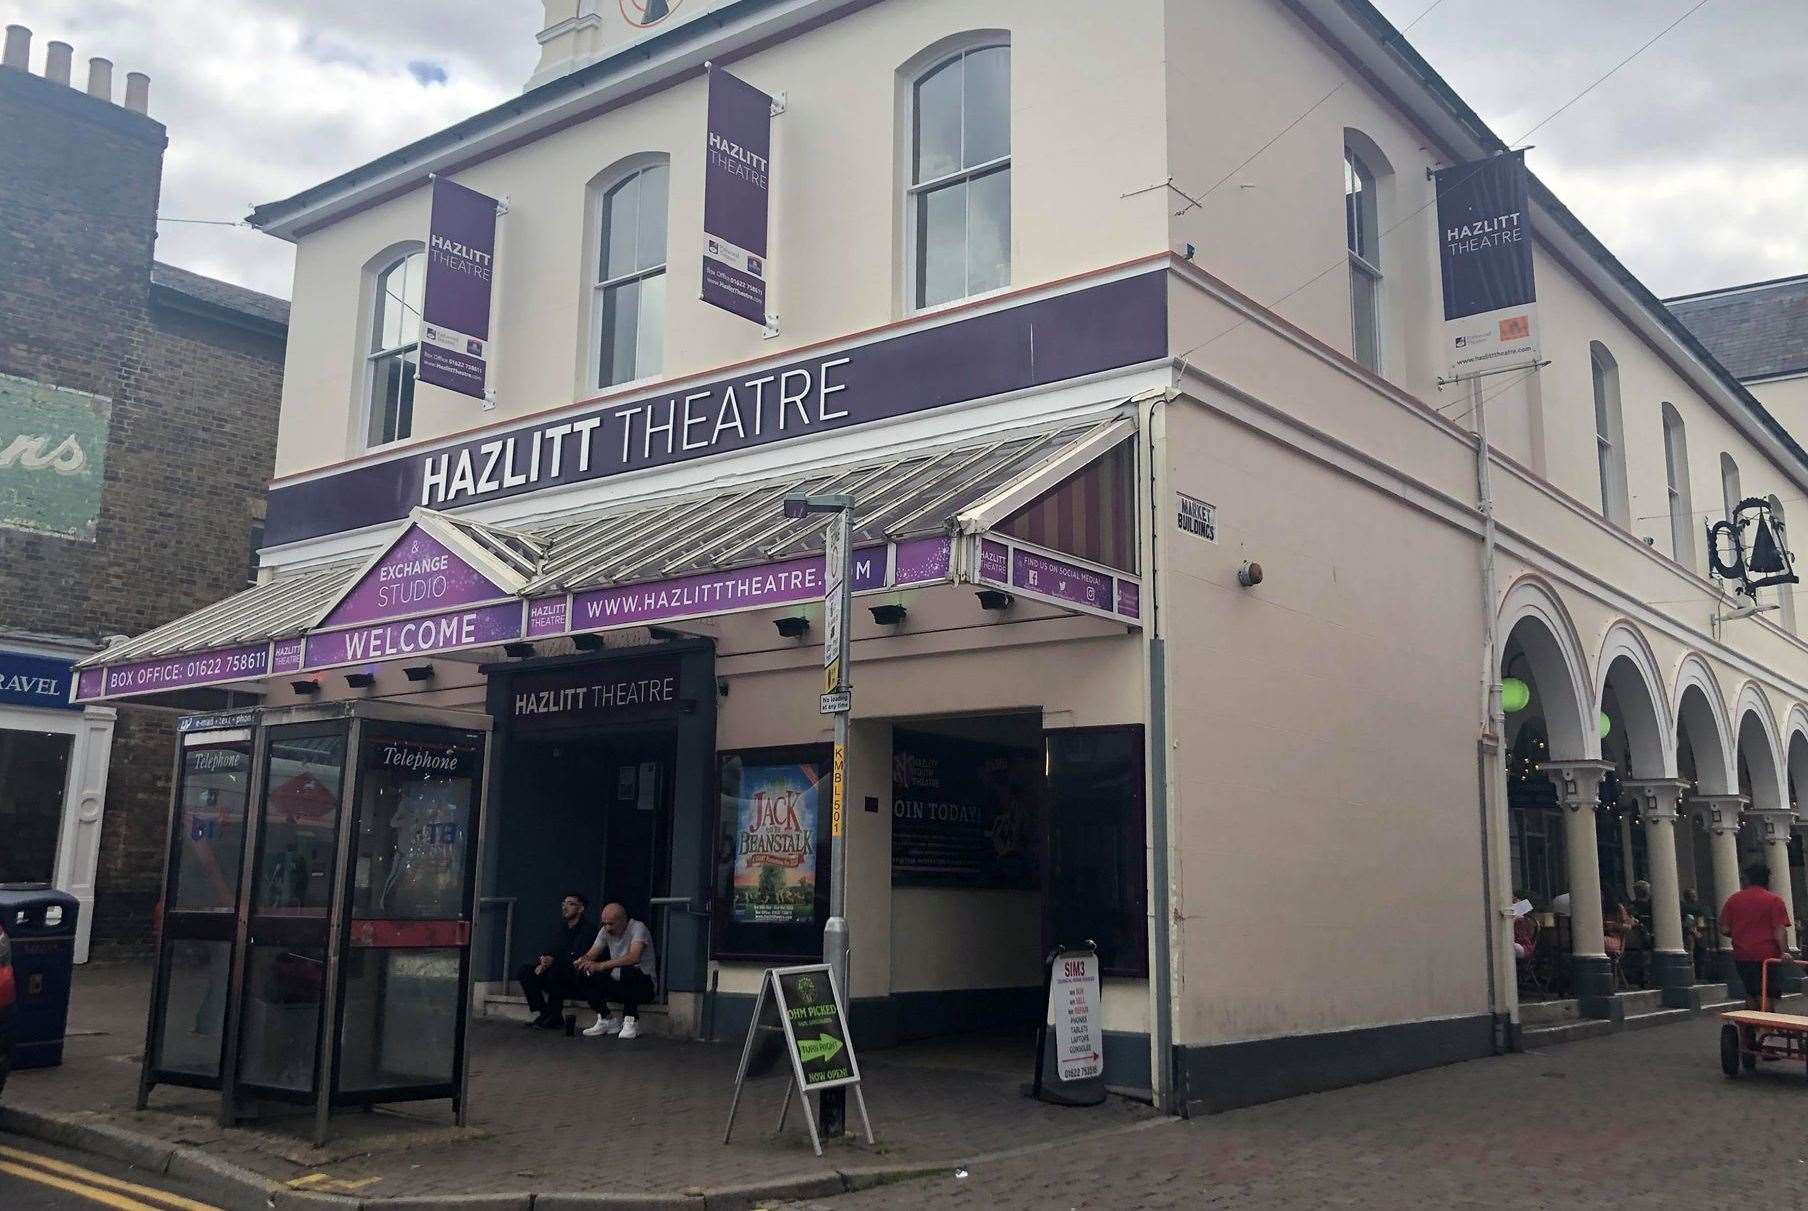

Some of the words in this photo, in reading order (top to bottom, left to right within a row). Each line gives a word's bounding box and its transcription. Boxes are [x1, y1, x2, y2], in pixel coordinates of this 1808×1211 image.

[708, 132, 768, 172] HAZLITT
[709, 149, 768, 191] THEATRE
[1447, 212, 1521, 242] HAZLITT
[1448, 227, 1522, 256] THEATRE
[431, 234, 491, 266] HAZLITT
[432, 249, 490, 281] THEATRE
[421, 417, 601, 506] HAZLITT
[615, 357, 850, 463] THEATRE
[1181, 498, 1211, 523] MARKET
[1177, 512, 1215, 541] BUILDINGS
[411, 540, 421, 554] &
[380, 554, 449, 582] EXCHANGE
[1024, 556, 1039, 567] FIND
[1039, 560, 1048, 570] US
[1048, 564, 1058, 574] ON
[1058, 567, 1080, 580] SOCIAL
[377, 575, 448, 608] STUDIO
[587, 559, 871, 618] WWW.HAZLITTTHEATRE.M
[531, 603, 567, 618] HAZLITT
[531, 616, 566, 628] THEATRE
[345, 613, 477, 660] WELCOME
[110, 670, 133, 688] BOX
[137, 664, 183, 684] OFFICE:
[187, 658, 221, 677] 01622
[225, 651, 266, 672] 758611
[515, 687, 587, 716] HAZLITT
[591, 677, 674, 708] THEATRE
[195, 752, 240, 772] Telephone
[383, 747, 458, 771] Telephone
[750, 790, 801, 833] JACK
[894, 799, 923, 819] OIN
[738, 830, 814, 856] BEANSTALK
